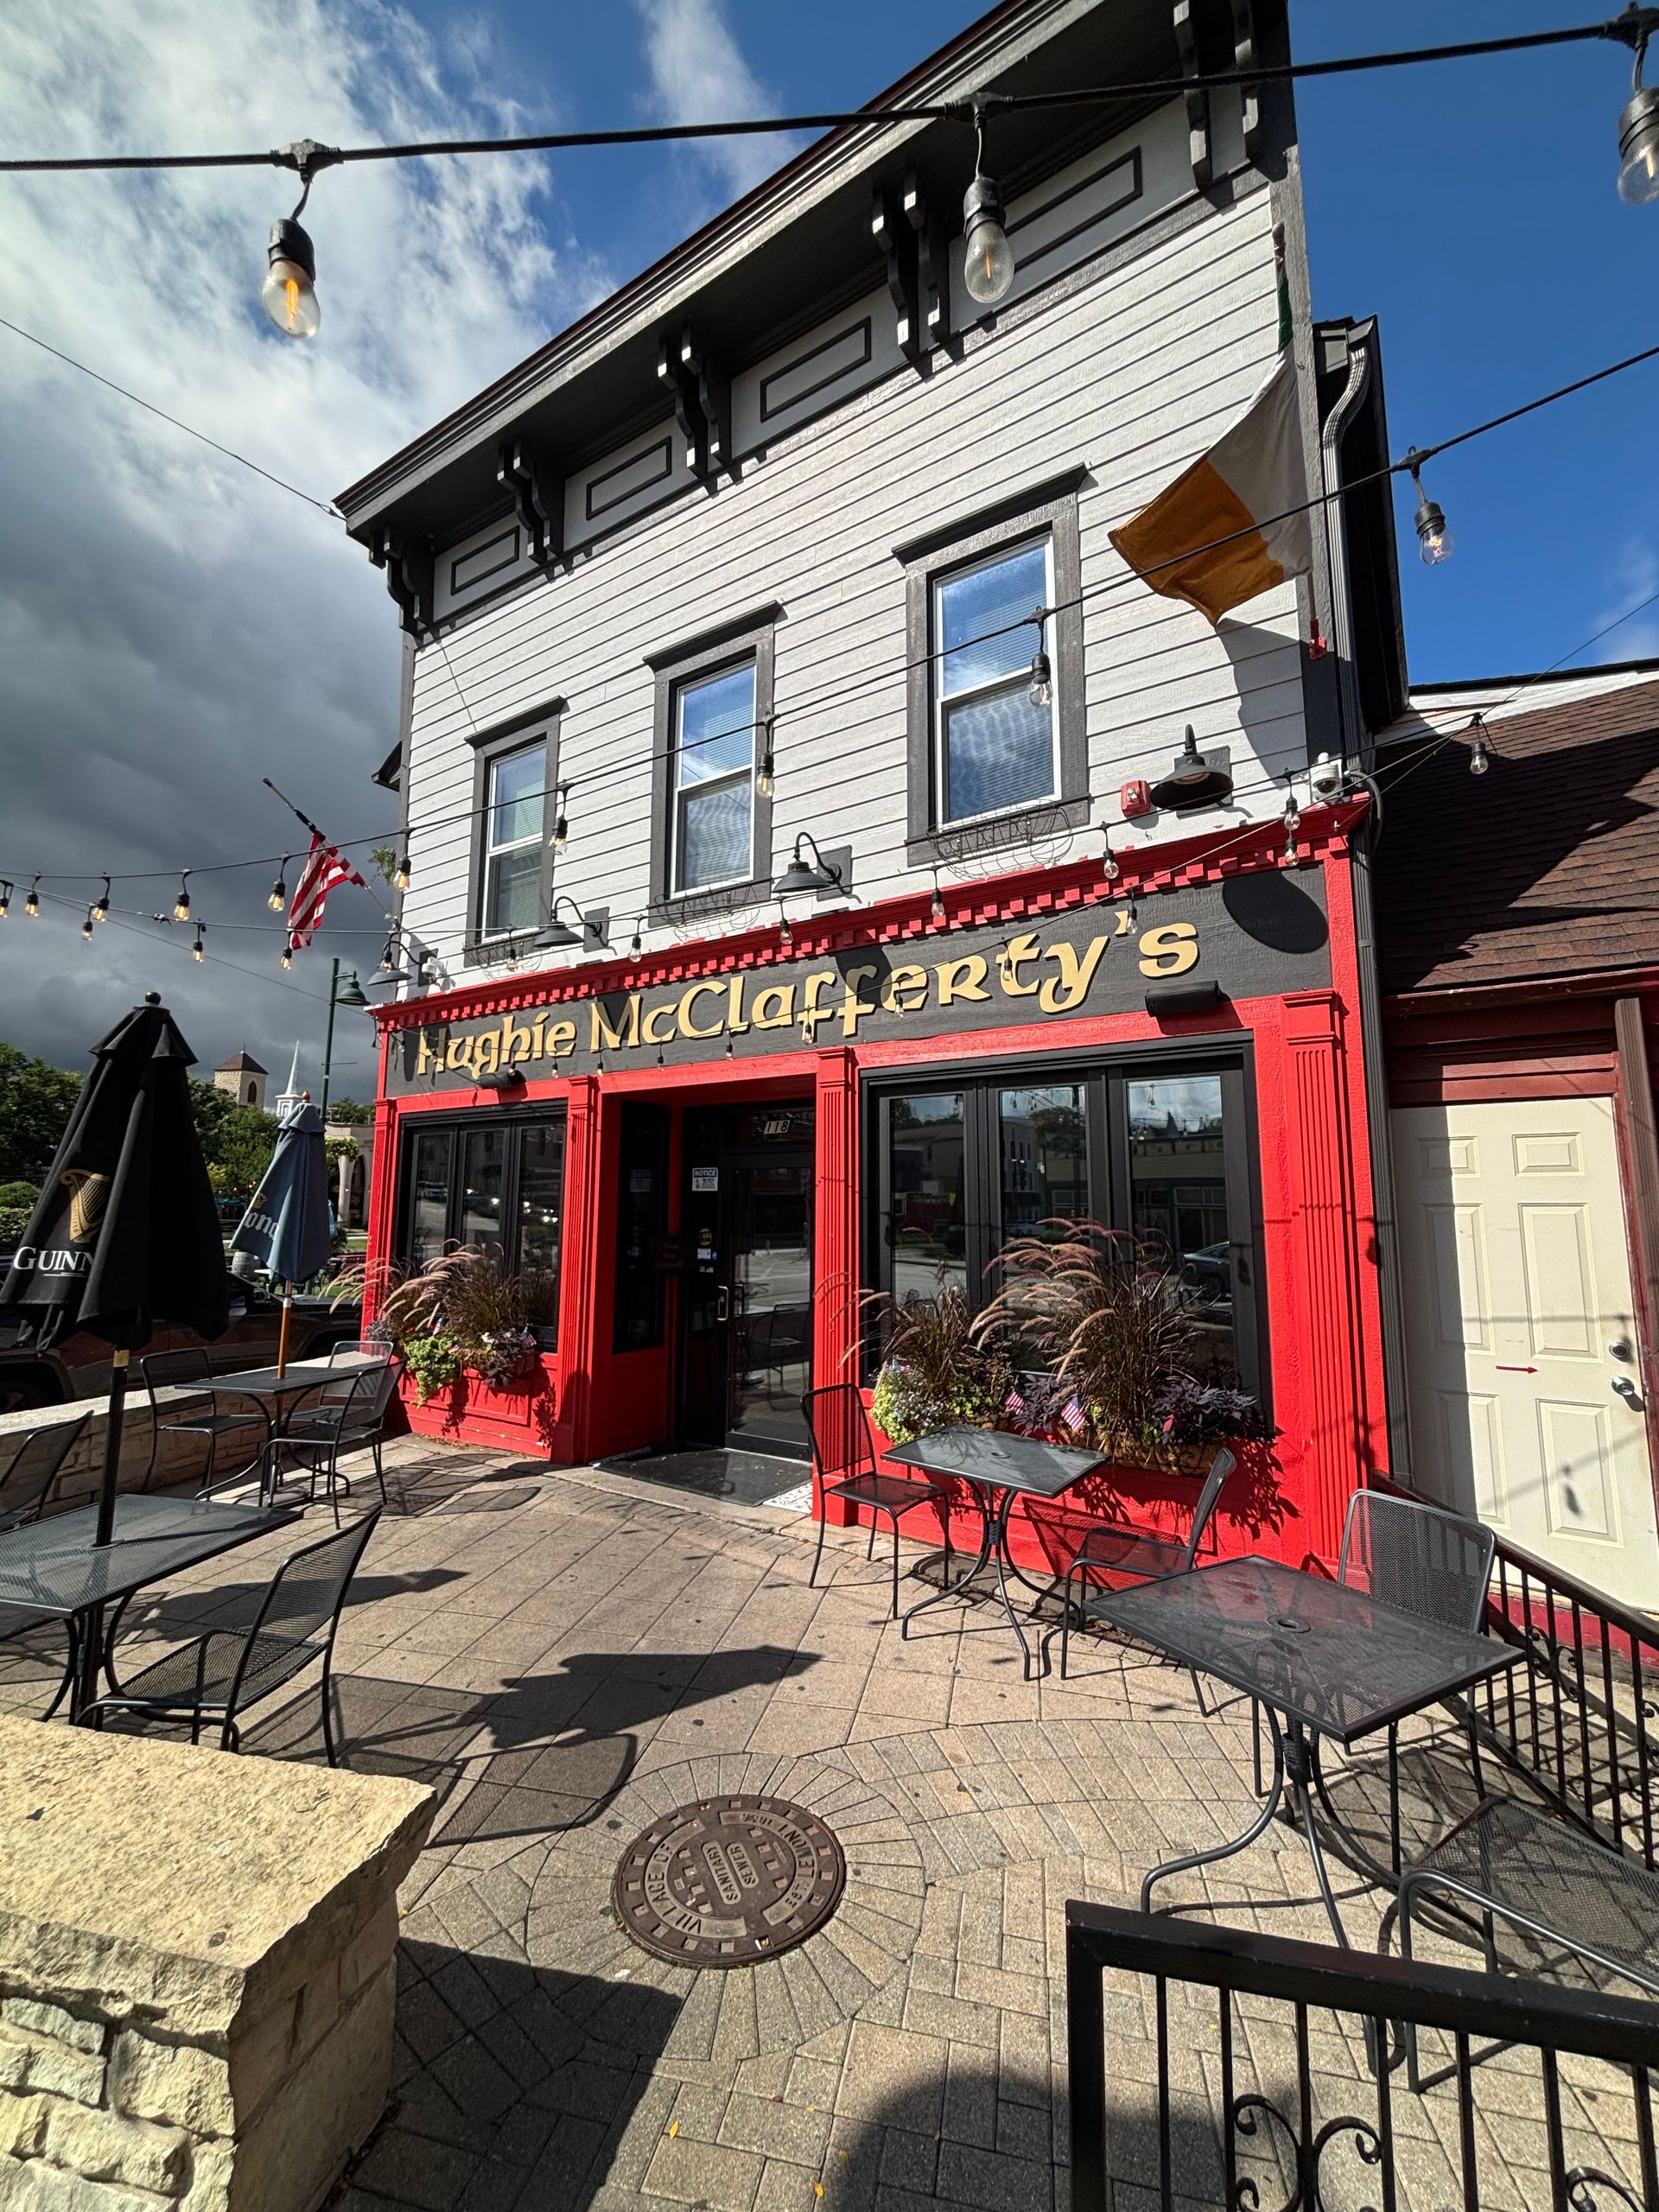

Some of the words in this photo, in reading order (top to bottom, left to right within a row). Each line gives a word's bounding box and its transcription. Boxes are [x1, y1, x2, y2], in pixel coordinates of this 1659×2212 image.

[417, 1012, 576, 1080] Hughie
[590, 910, 1199, 1053] McClafferty's
[766, 1121, 789, 1133] 118
[654, 1843, 673, 1863] OF
[706, 1846, 738, 1901] SANITARY
[730, 1845, 756, 1885] SEWER
[778, 1824, 814, 1878] LEMONT
[648, 1872, 702, 1935] VILLAGE
